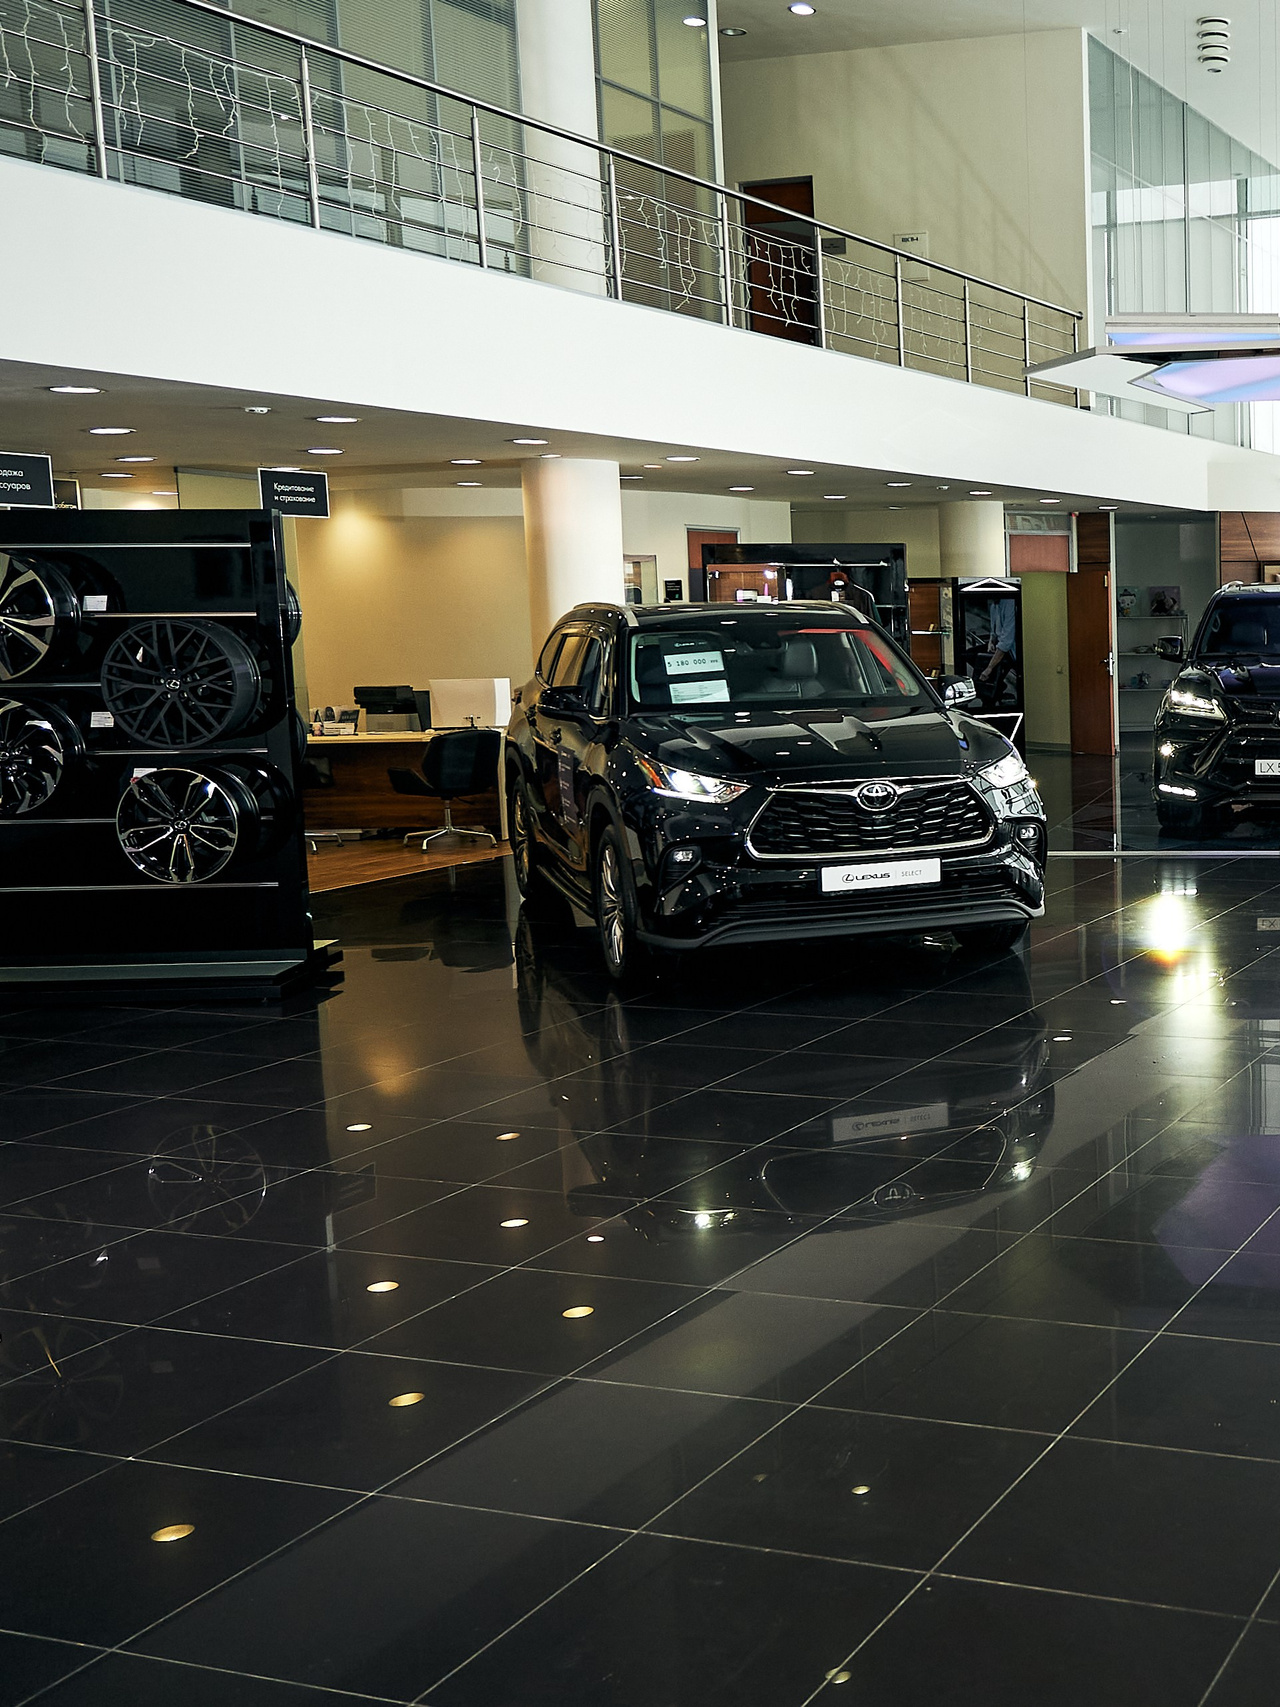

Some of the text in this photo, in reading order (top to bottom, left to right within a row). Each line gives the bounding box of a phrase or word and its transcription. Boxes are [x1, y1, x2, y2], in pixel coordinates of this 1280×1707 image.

[273, 482, 315, 493] Кредитование
[280, 495, 316, 503] страхование
[1260, 762, 1275, 774] LX
[855, 869, 923, 881] LEXUS SELECT
